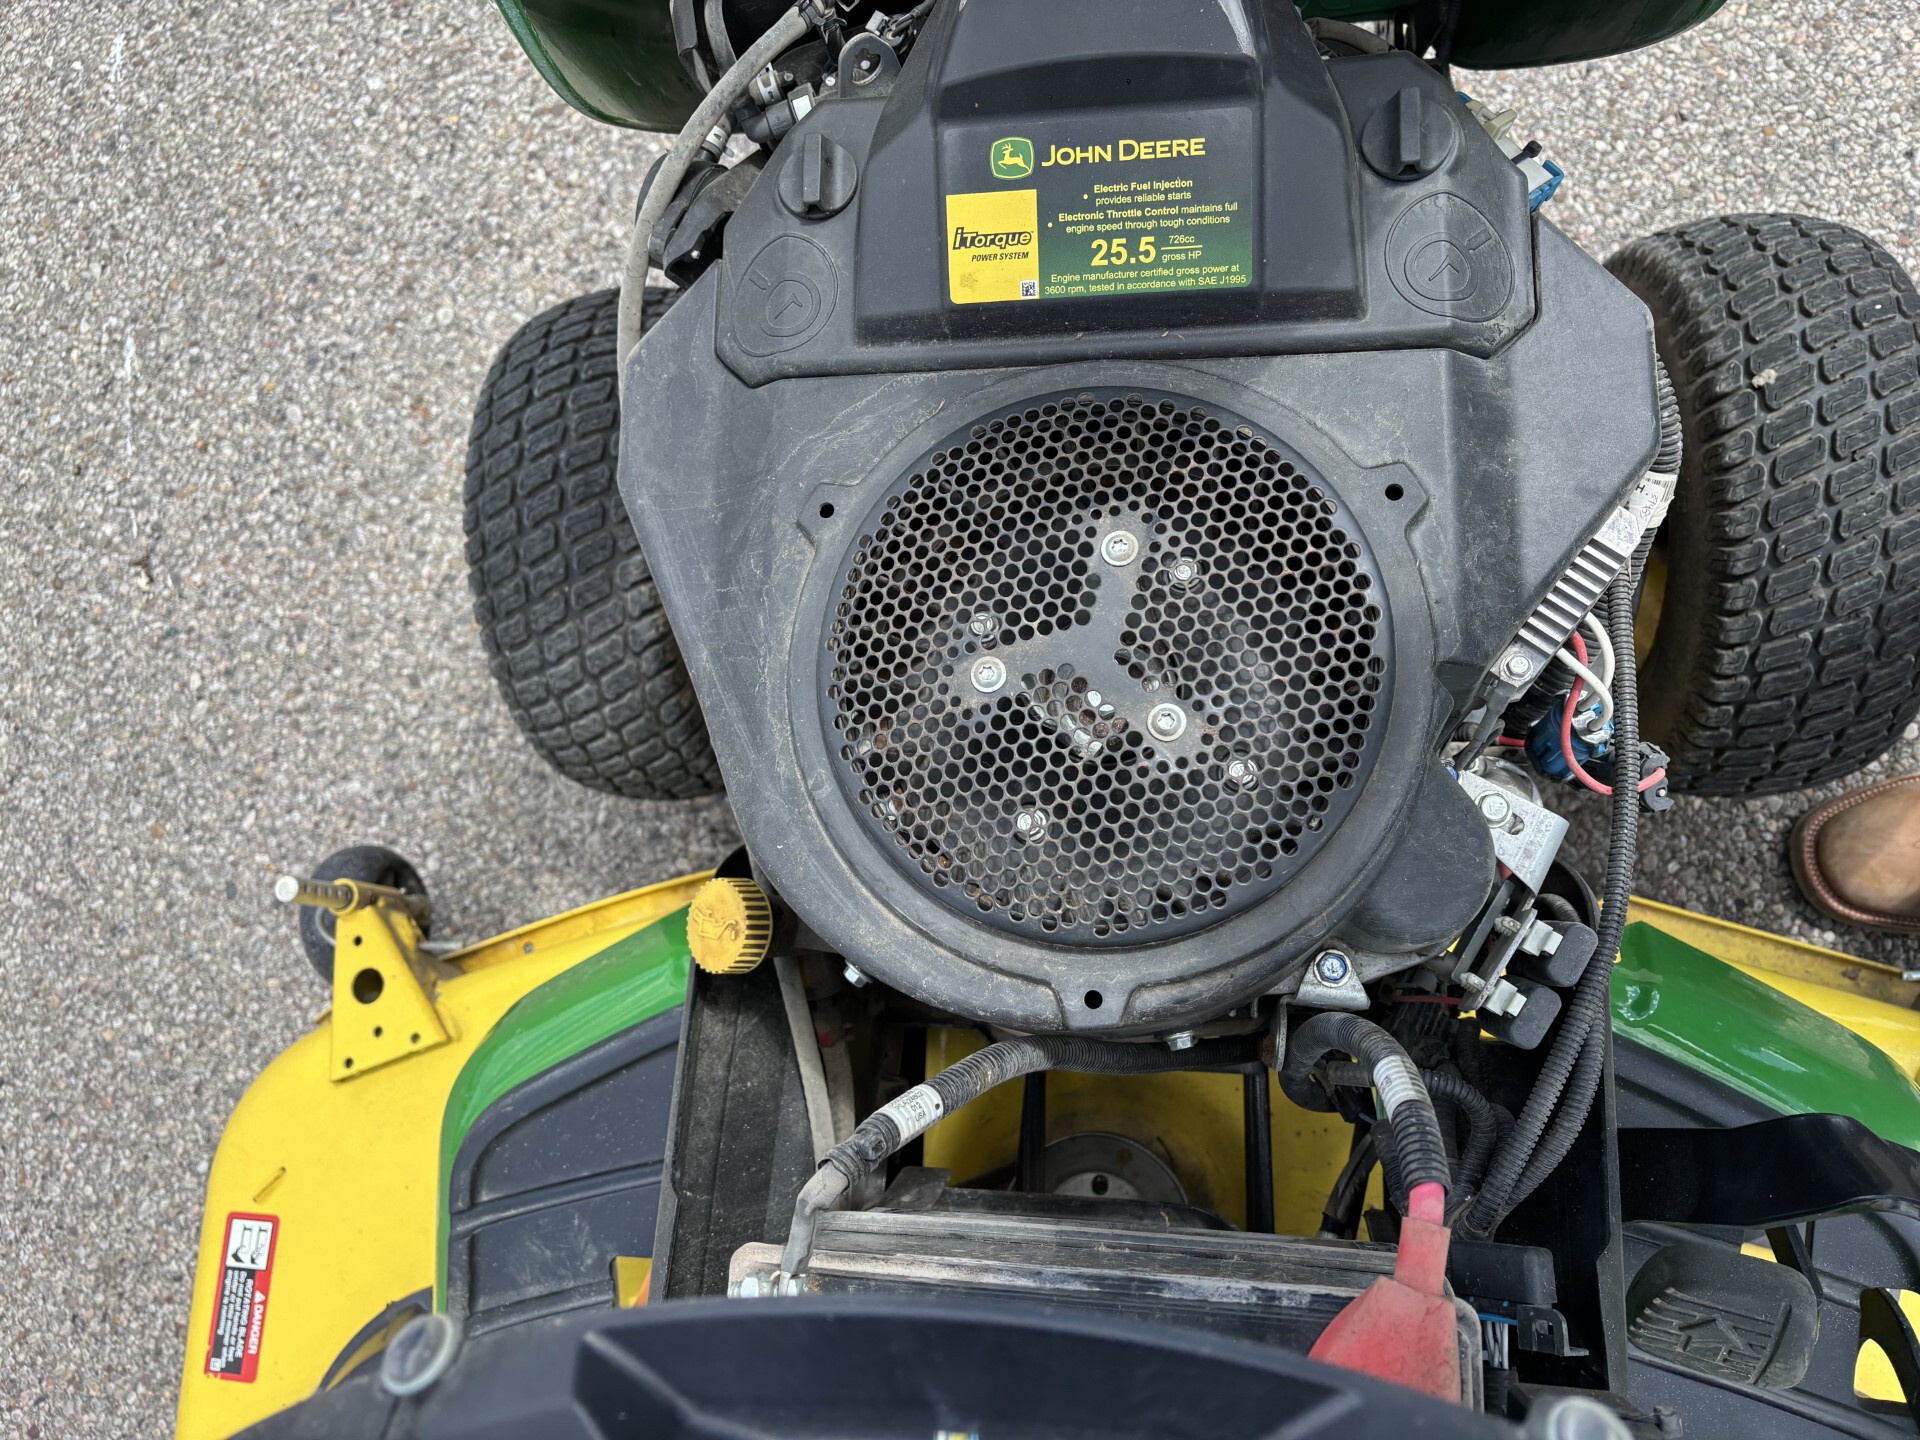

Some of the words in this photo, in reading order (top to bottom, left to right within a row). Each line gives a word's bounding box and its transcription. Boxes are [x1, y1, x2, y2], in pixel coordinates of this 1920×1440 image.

[1041, 144, 1112, 167] JOHN
[1118, 137, 1206, 162] DEERE
[1094, 183, 1129, 194] Electric
[1130, 181, 1151, 191] Fuel
[1153, 179, 1193, 191] Injection
[1095, 195, 1132, 207] provides
[1134, 193, 1166, 203] reliable
[1167, 191, 1192, 201] starts
[1058, 211, 1105, 222] Electronic
[1106, 208, 1142, 219] Throttle
[1144, 206, 1180, 217] Control
[1181, 203, 1223, 215] maintains
[1224, 202, 1239, 212] full
[1066, 223, 1095, 235] engine
[1096, 221, 1124, 233] speed
[1125, 219, 1158, 231] through
[1160, 218, 1185, 229] tough
[1186, 215, 1231, 226] conditions
[1168, 235, 1196, 245] 726cc
[971, 253, 998, 262] POWER
[999, 252, 1030, 261] SYSTEM
[1090, 236, 1157, 267] 25.5
[1161, 253, 1186, 263] gross
[1187, 250, 1203, 260] HP
[1051, 273, 1081, 284] Engine
[1082, 270, 1139, 281] manufacturer
[1140, 266, 1175, 278] certified
[1176, 267, 1200, 278] gross
[1201, 265, 1229, 276] power
[1230, 263, 1240, 273] at
[1044, 285, 1066, 295] 3600
[1067, 285, 1087, 296] rpm,
[1089, 281, 1115, 292] tested
[1116, 280, 1125, 291] in
[1126, 278, 1176, 290] accordance
[1178, 276, 1196, 287] with
[1198, 276, 1218, 286] SAE
[1219, 274, 1247, 285] J1995
[240, 1278, 254, 1326] ROTATING
[247, 1304, 264, 1355] DANGER
[234, 1326, 247, 1359] BLADE
